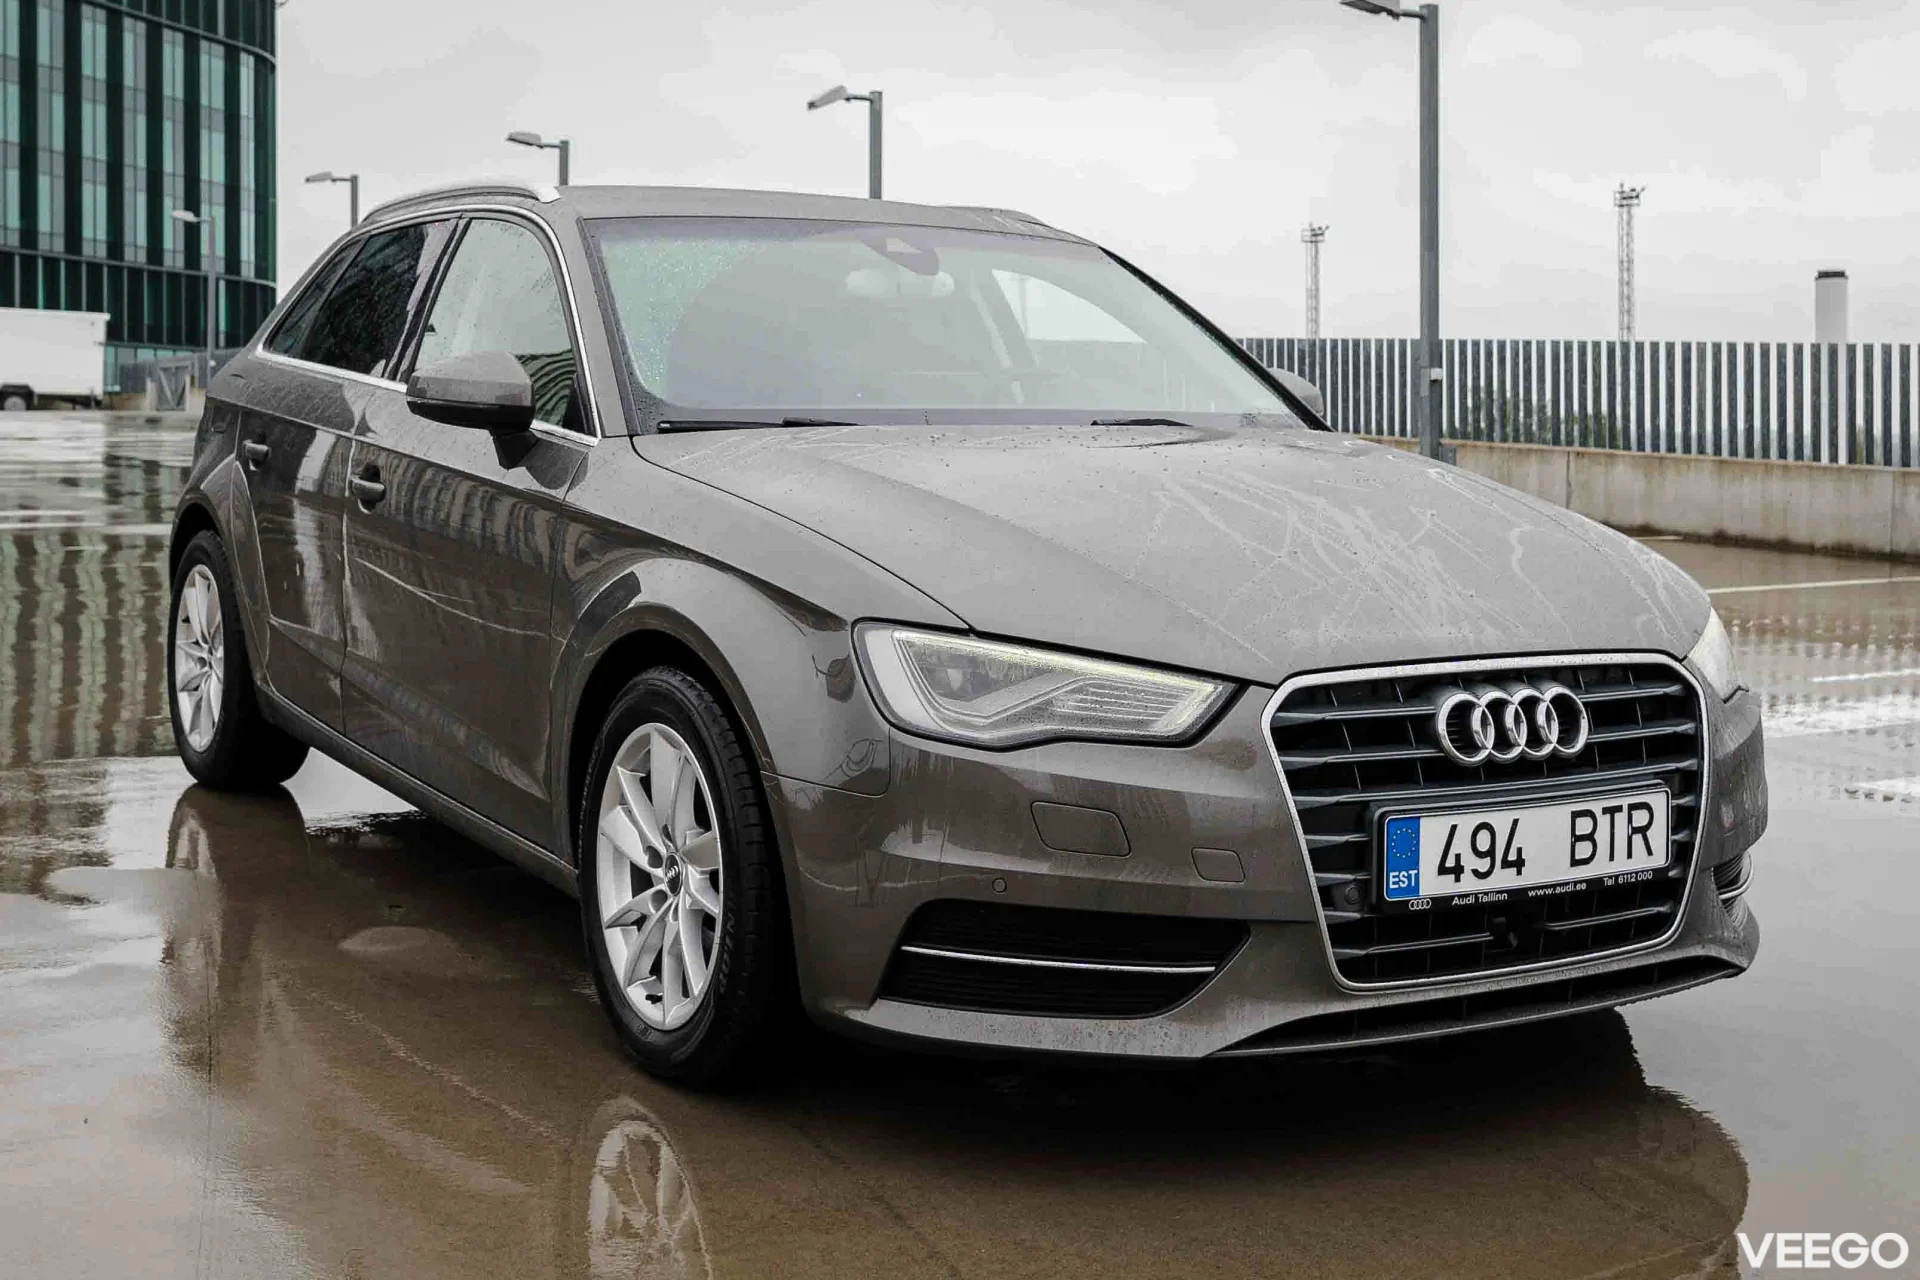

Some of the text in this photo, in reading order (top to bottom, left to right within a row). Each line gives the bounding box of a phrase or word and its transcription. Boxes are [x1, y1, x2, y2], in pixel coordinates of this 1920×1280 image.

[1437, 801, 1655, 883] 494 BTR
[1389, 869, 1418, 889] EST
[1451, 870, 1653, 906] Audi Tallinn www.audi.ee Tel 6112 000
